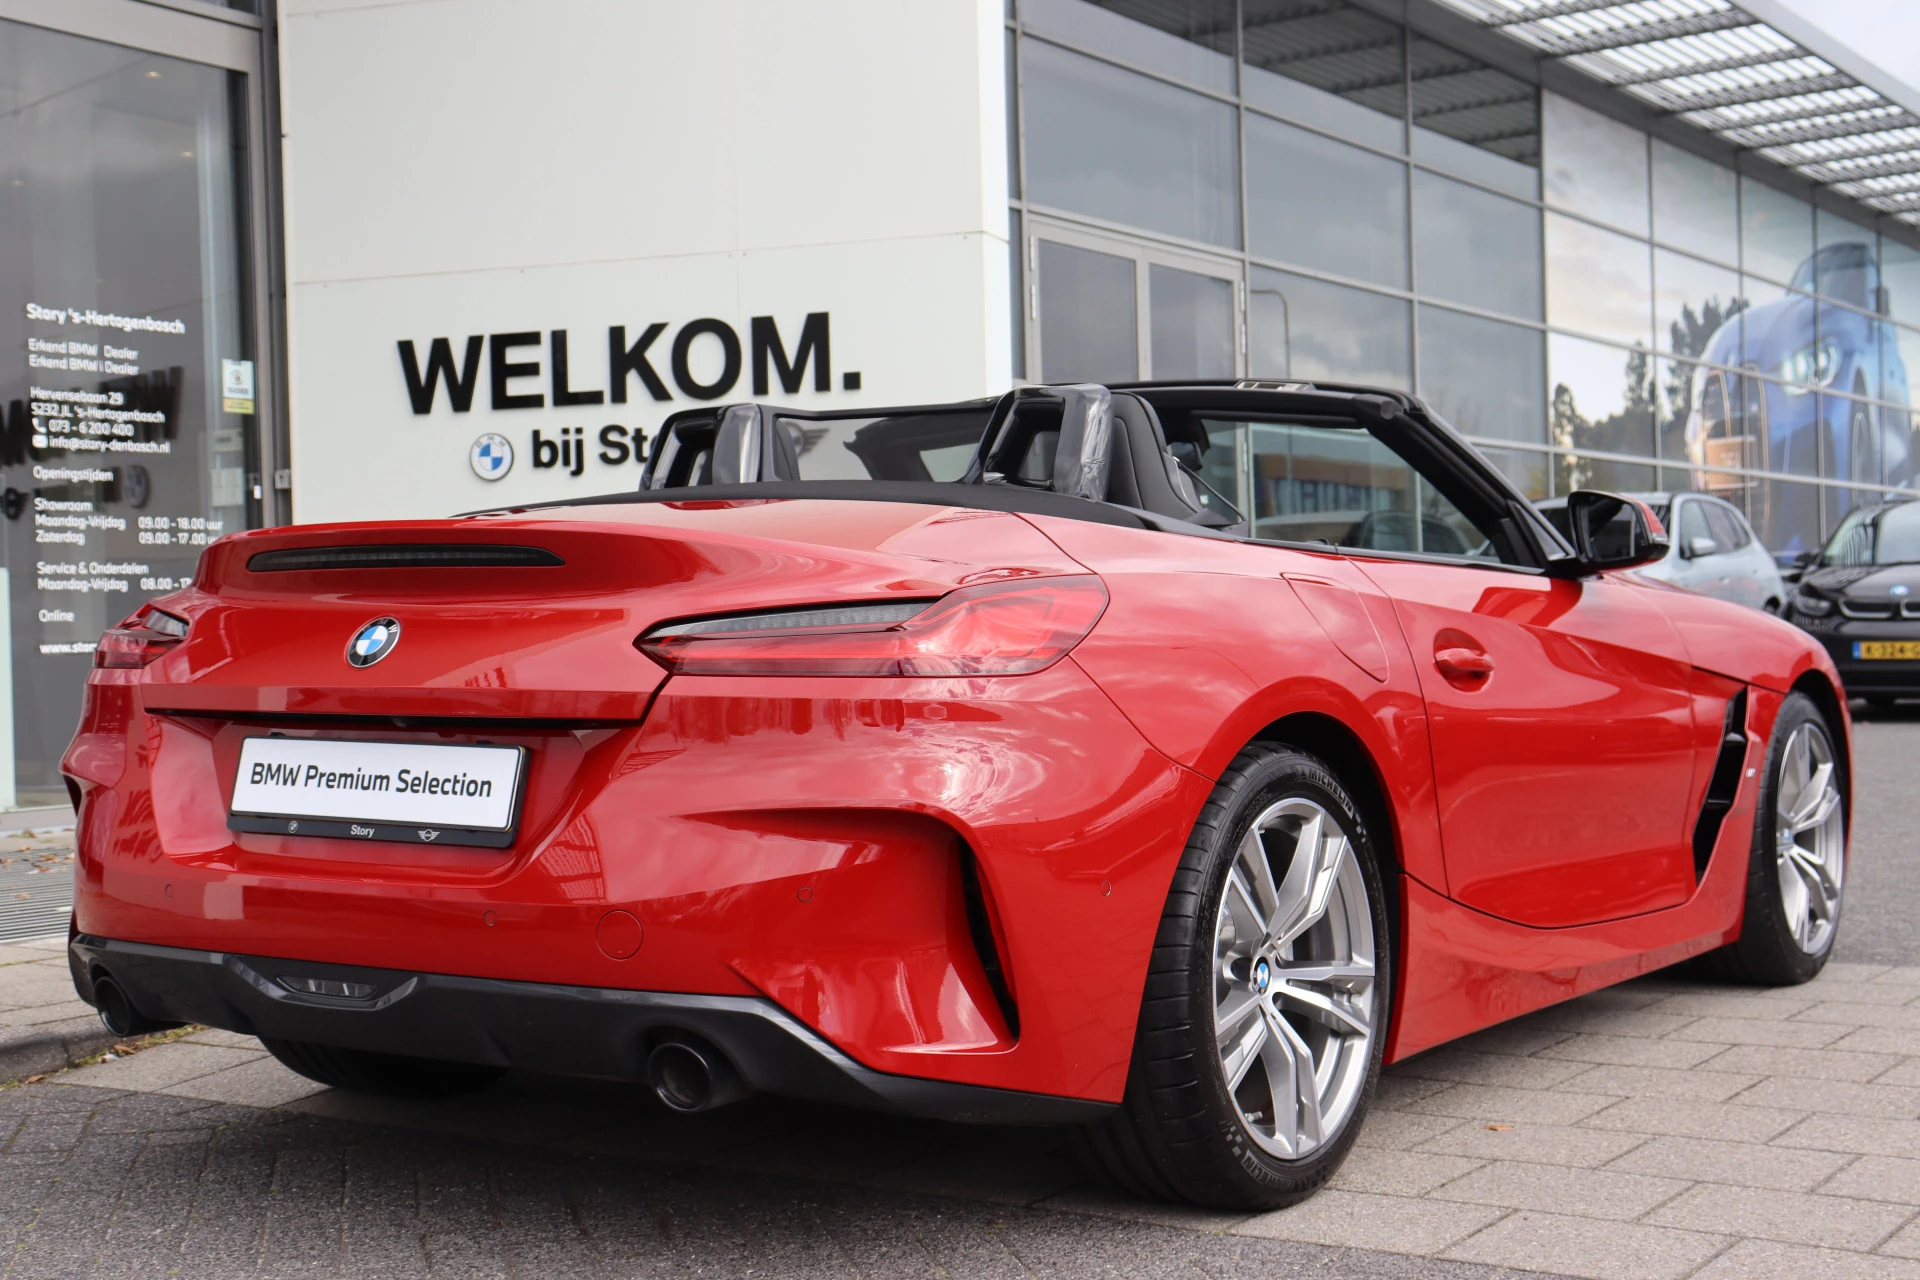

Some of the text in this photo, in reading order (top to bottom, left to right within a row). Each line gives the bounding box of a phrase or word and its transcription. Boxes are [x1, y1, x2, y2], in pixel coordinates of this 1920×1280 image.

[26, 303, 185, 334] Story 's-Hertogenbosch
[28, 338, 138, 360] Erkend BMW Dealer
[29, 354, 68, 370] Erkend
[69, 358, 98, 372] BMW
[105, 361, 139, 376] Dealer
[397, 311, 861, 415] WELKOM.
[30, 386, 124, 405] Hervensebaan 29
[31, 402, 165, 423] 5232 JL 's-Hertogenbosch
[49, 419, 70, 433] 073
[79, 422, 88, 434] 6
[88, 422, 111, 436] 200
[111, 423, 134, 437] 400
[49, 436, 170, 454] info@story-denbosch.nl
[531, 425, 658, 476] bij St
[33, 466, 113, 482] Openingstijden
[34, 498, 93, 512] Showroom
[35, 514, 126, 531] Maandag-Vrijdag
[138, 516, 170, 530] 09.00
[206, 520, 223, 531] uur
[36, 530, 86, 546] Zaterdag
[138, 532, 170, 545] 09.00
[37, 561, 149, 575] Service & Onderdelen
[37, 577, 128, 593] Maandag-Vrijdag
[39, 609, 75, 622] Online
[250, 762, 492, 797] BMW Premium Selection
[350, 824, 375, 838] Story
